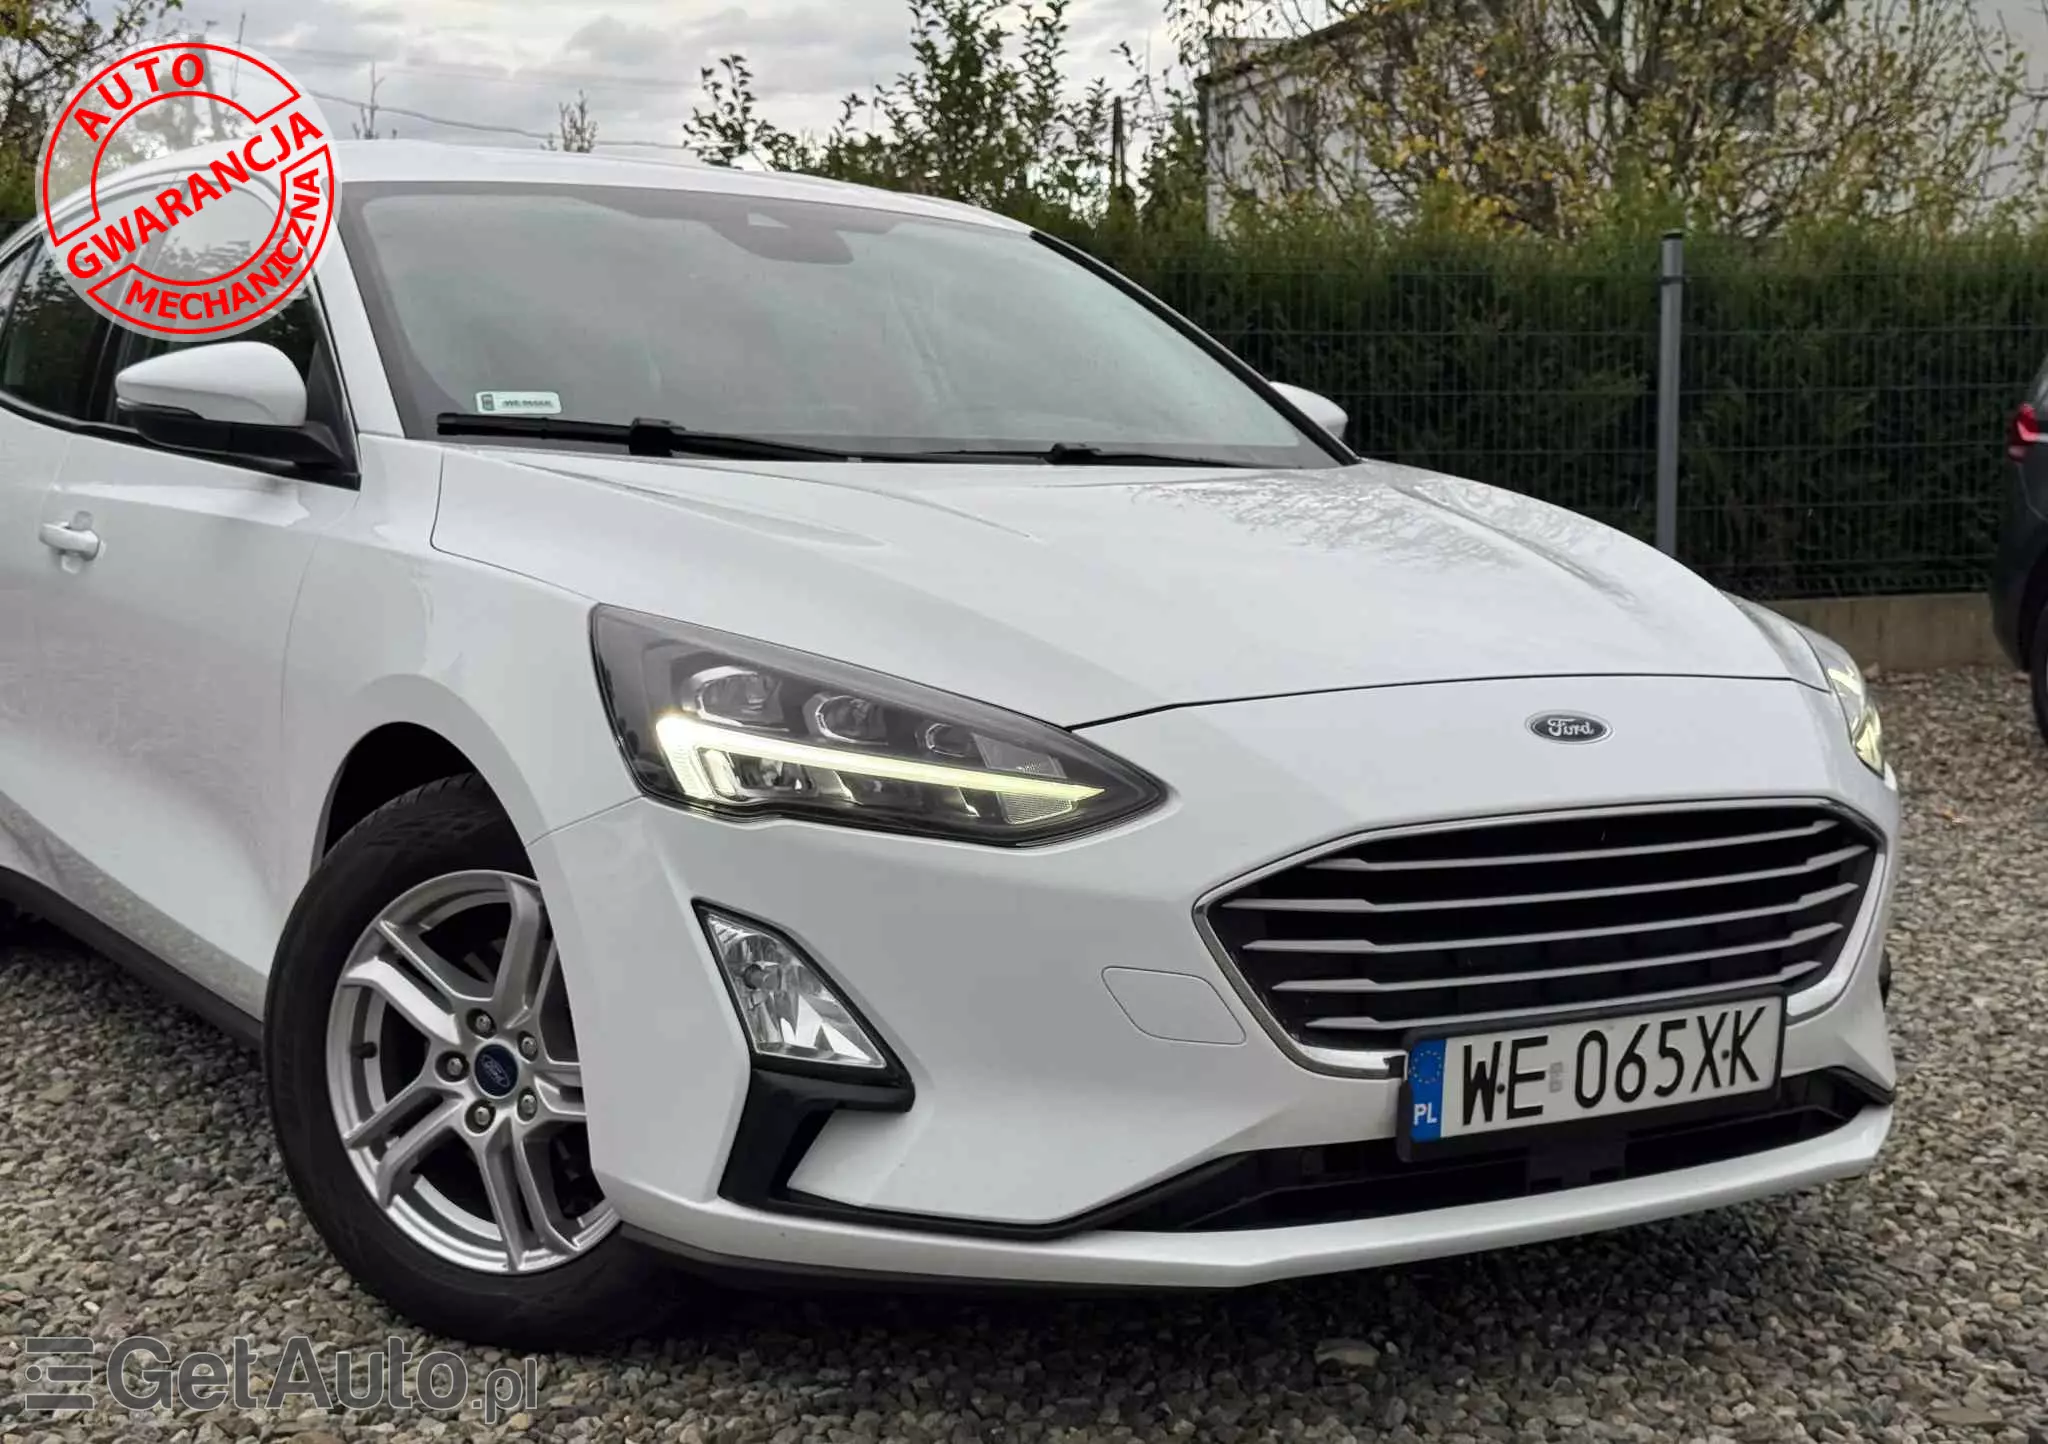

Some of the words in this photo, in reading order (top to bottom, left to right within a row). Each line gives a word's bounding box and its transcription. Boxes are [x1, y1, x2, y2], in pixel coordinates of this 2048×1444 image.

[1547, 718, 1594, 736] Ford
[1462, 1035, 1549, 1126] WE
[1574, 1006, 1766, 1109] 065XK
[1413, 1102, 1438, 1126] PL
